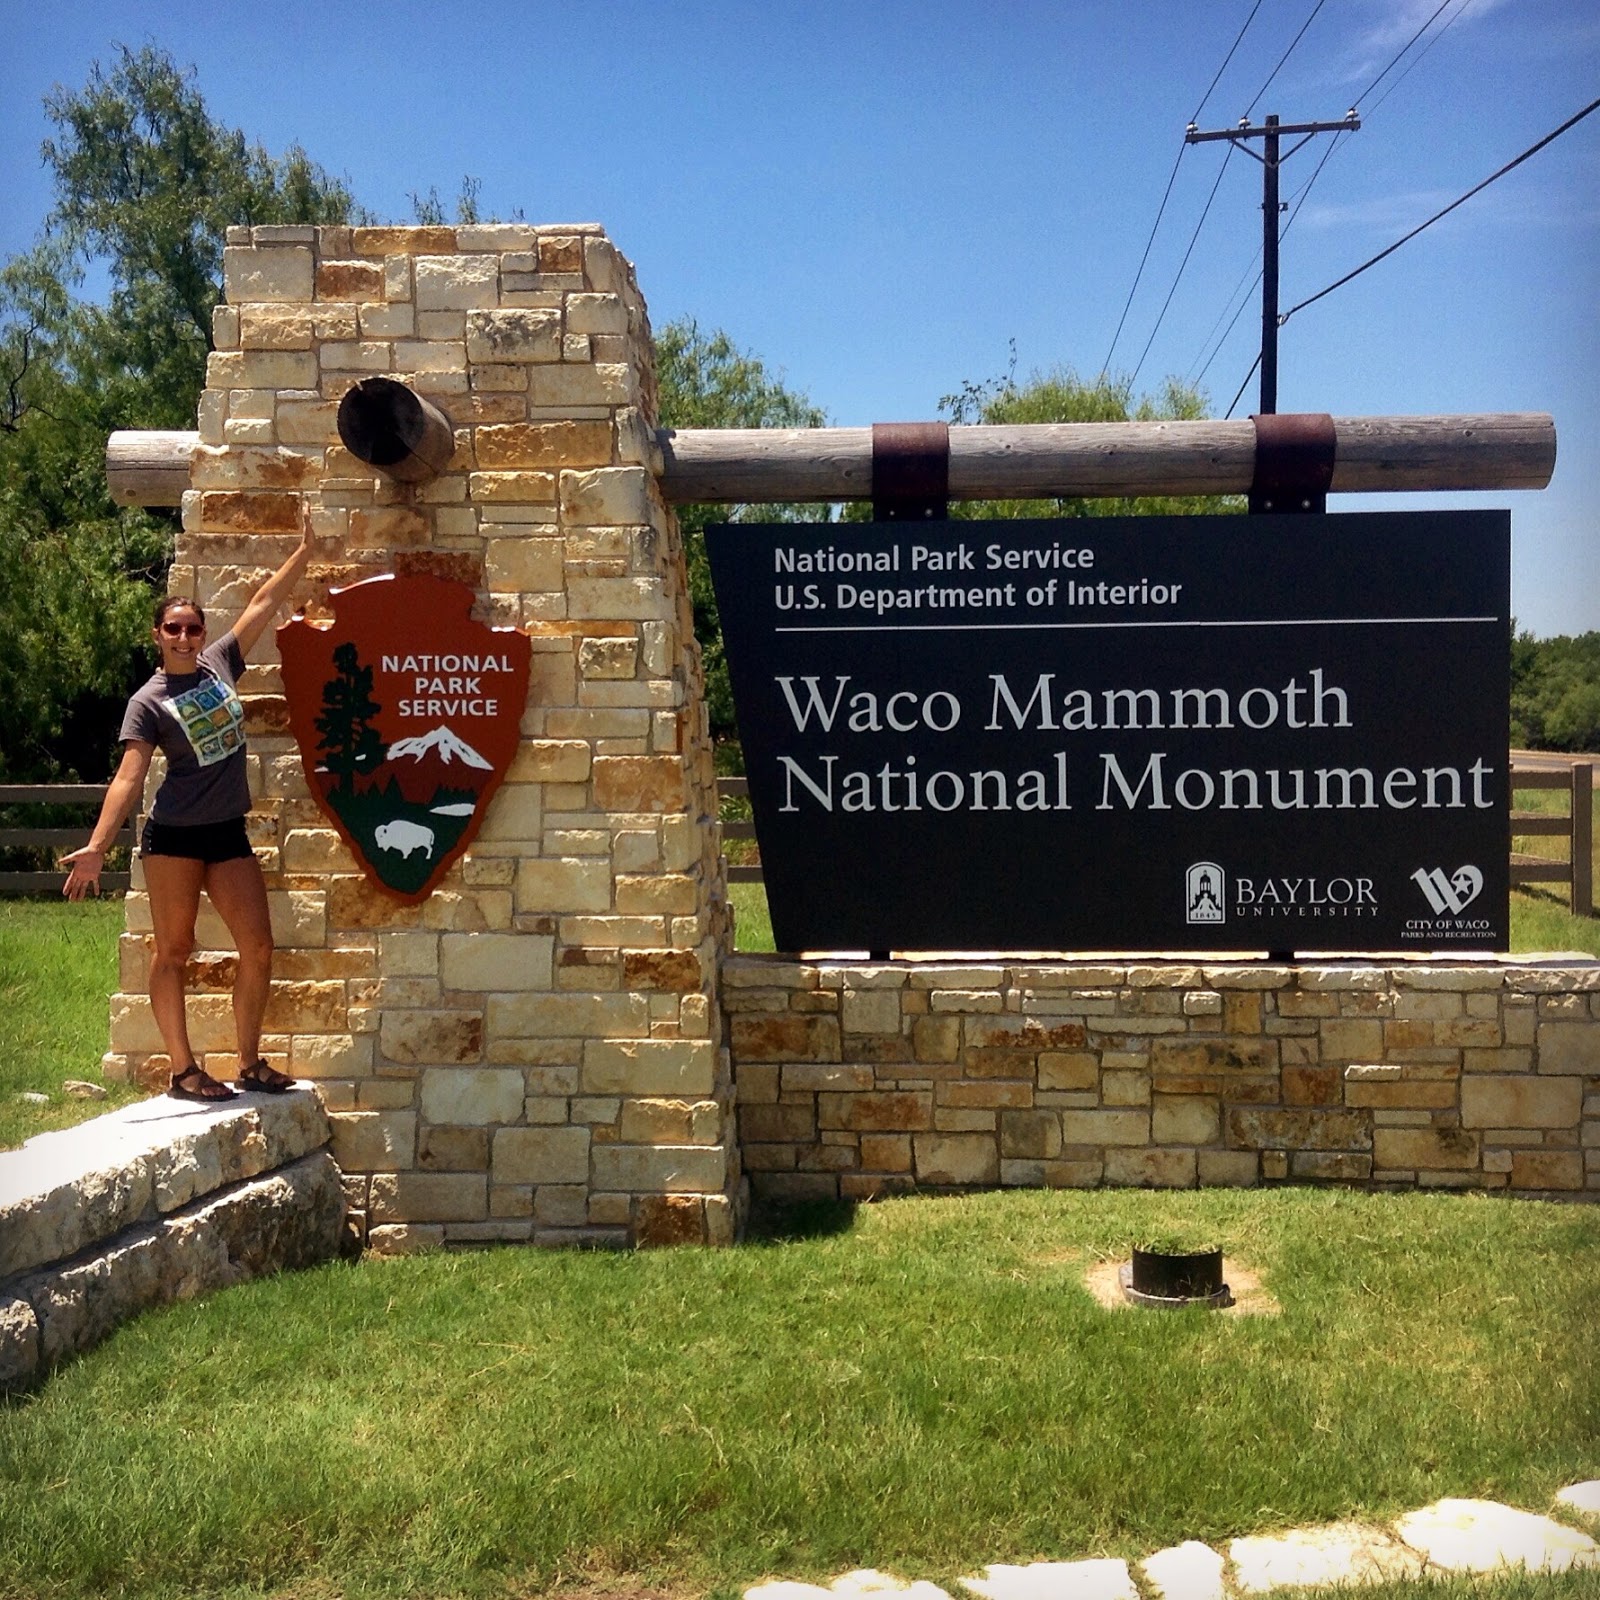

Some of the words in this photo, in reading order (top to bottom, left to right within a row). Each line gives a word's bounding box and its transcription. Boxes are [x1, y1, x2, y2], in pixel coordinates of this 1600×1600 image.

[775, 544, 899, 573] National
[912, 543, 975, 571] Park
[986, 543, 1094, 570] Service
[775, 584, 826, 611] U.S.
[837, 583, 1016, 615] Department
[1026, 579, 1058, 607] of
[1068, 578, 1183, 606] Interior
[381, 655, 514, 673] NATIONAL
[415, 677, 482, 695] PARK
[398, 699, 498, 717] SERVICE
[775, 675, 961, 733] Waco
[984, 667, 1354, 732] Mammoth
[776, 751, 1072, 813] National
[1095, 753, 1494, 811] Monument
[1235, 877, 1378, 904] BAYLOR
[1236, 906, 1379, 917] UNIVERSITY
[1405, 919, 1434, 930] CITY
[1435, 919, 1453, 930] OF
[1454, 919, 1490, 930] WACO
[1400, 931, 1425, 939] PARKS
[1425, 931, 1444, 939] AND
[1444, 931, 1497, 939] RECREATION
